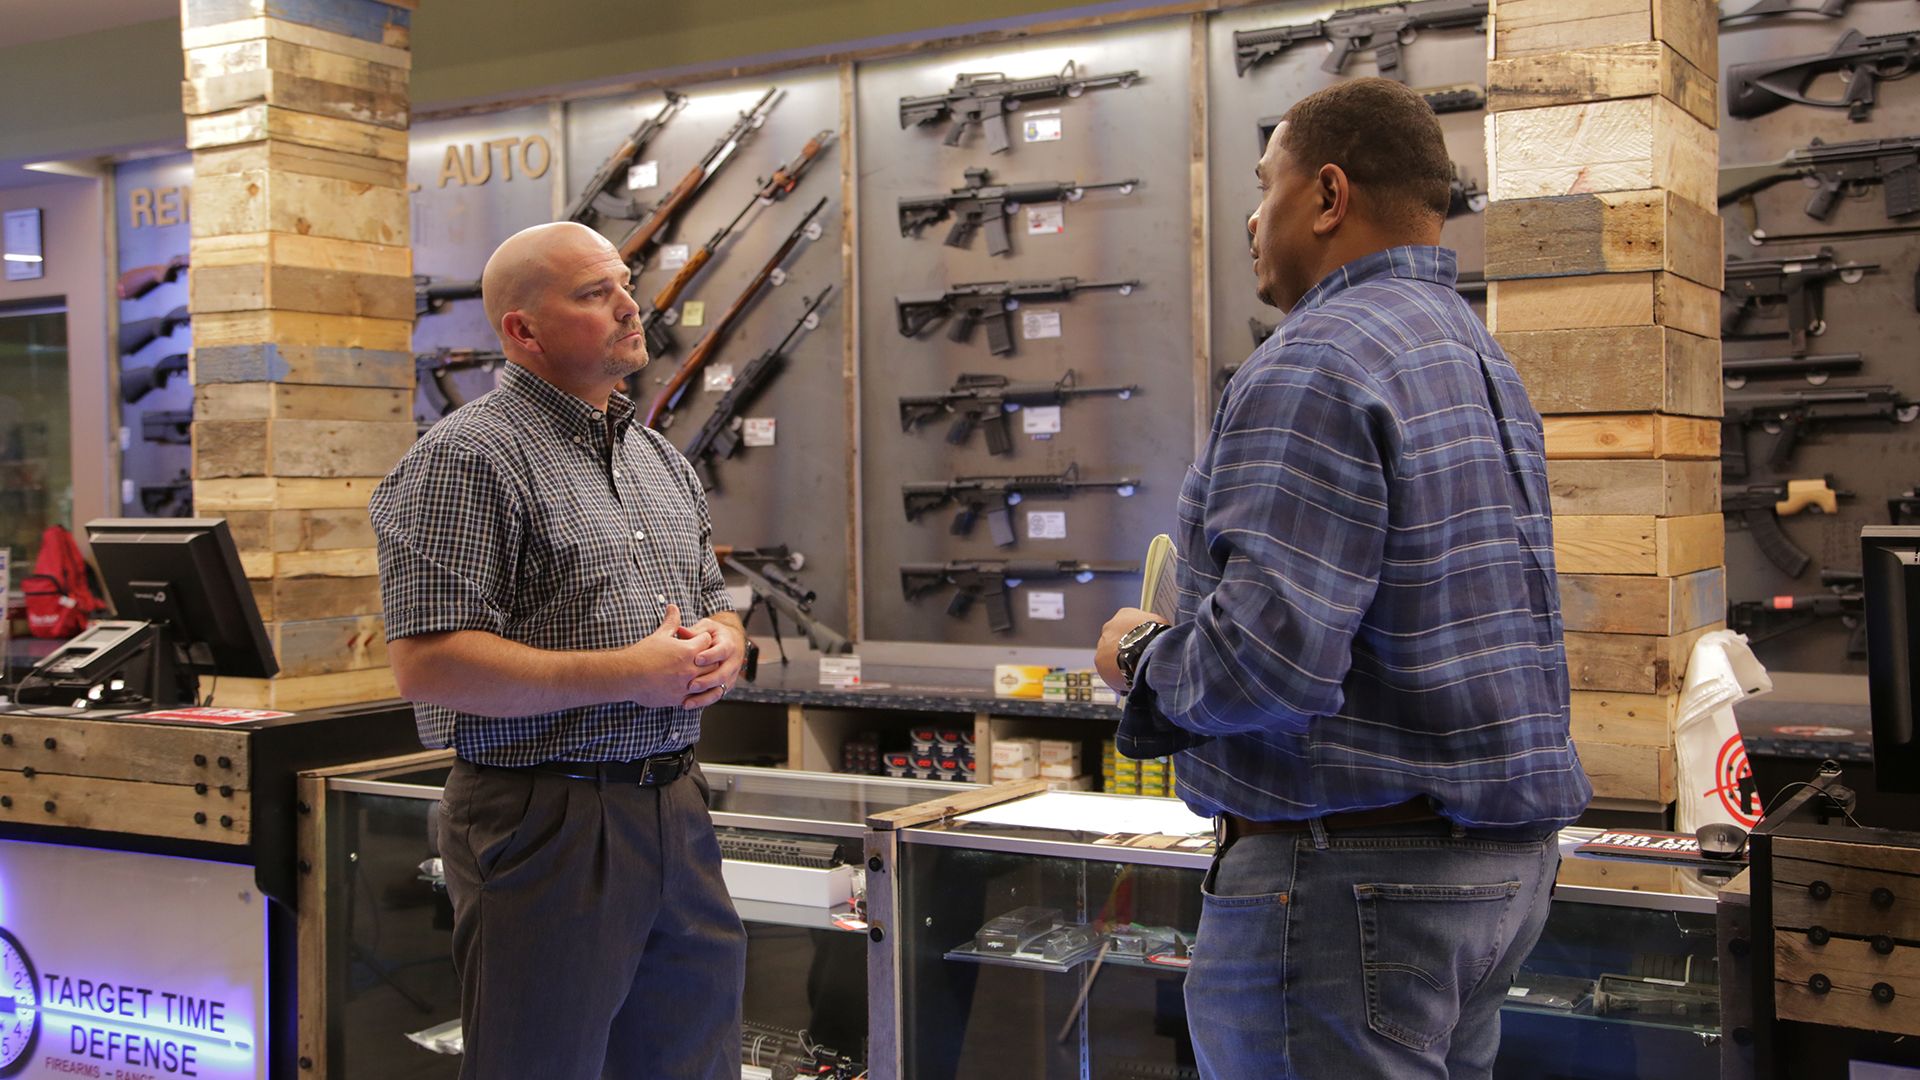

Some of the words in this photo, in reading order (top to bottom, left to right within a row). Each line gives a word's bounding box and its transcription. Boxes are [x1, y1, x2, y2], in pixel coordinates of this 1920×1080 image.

[438, 133, 552, 188] AUTO
[14, 971, 23, 990] 2
[44, 973, 153, 1019] TARGET
[161, 992, 226, 1034] TIME
[13, 1020, 22, 1038] 4
[2, 1037, 10, 1056] 5
[71, 1024, 198, 1078] DEFENSE
[45, 1056, 101, 1079] FIREARMS
